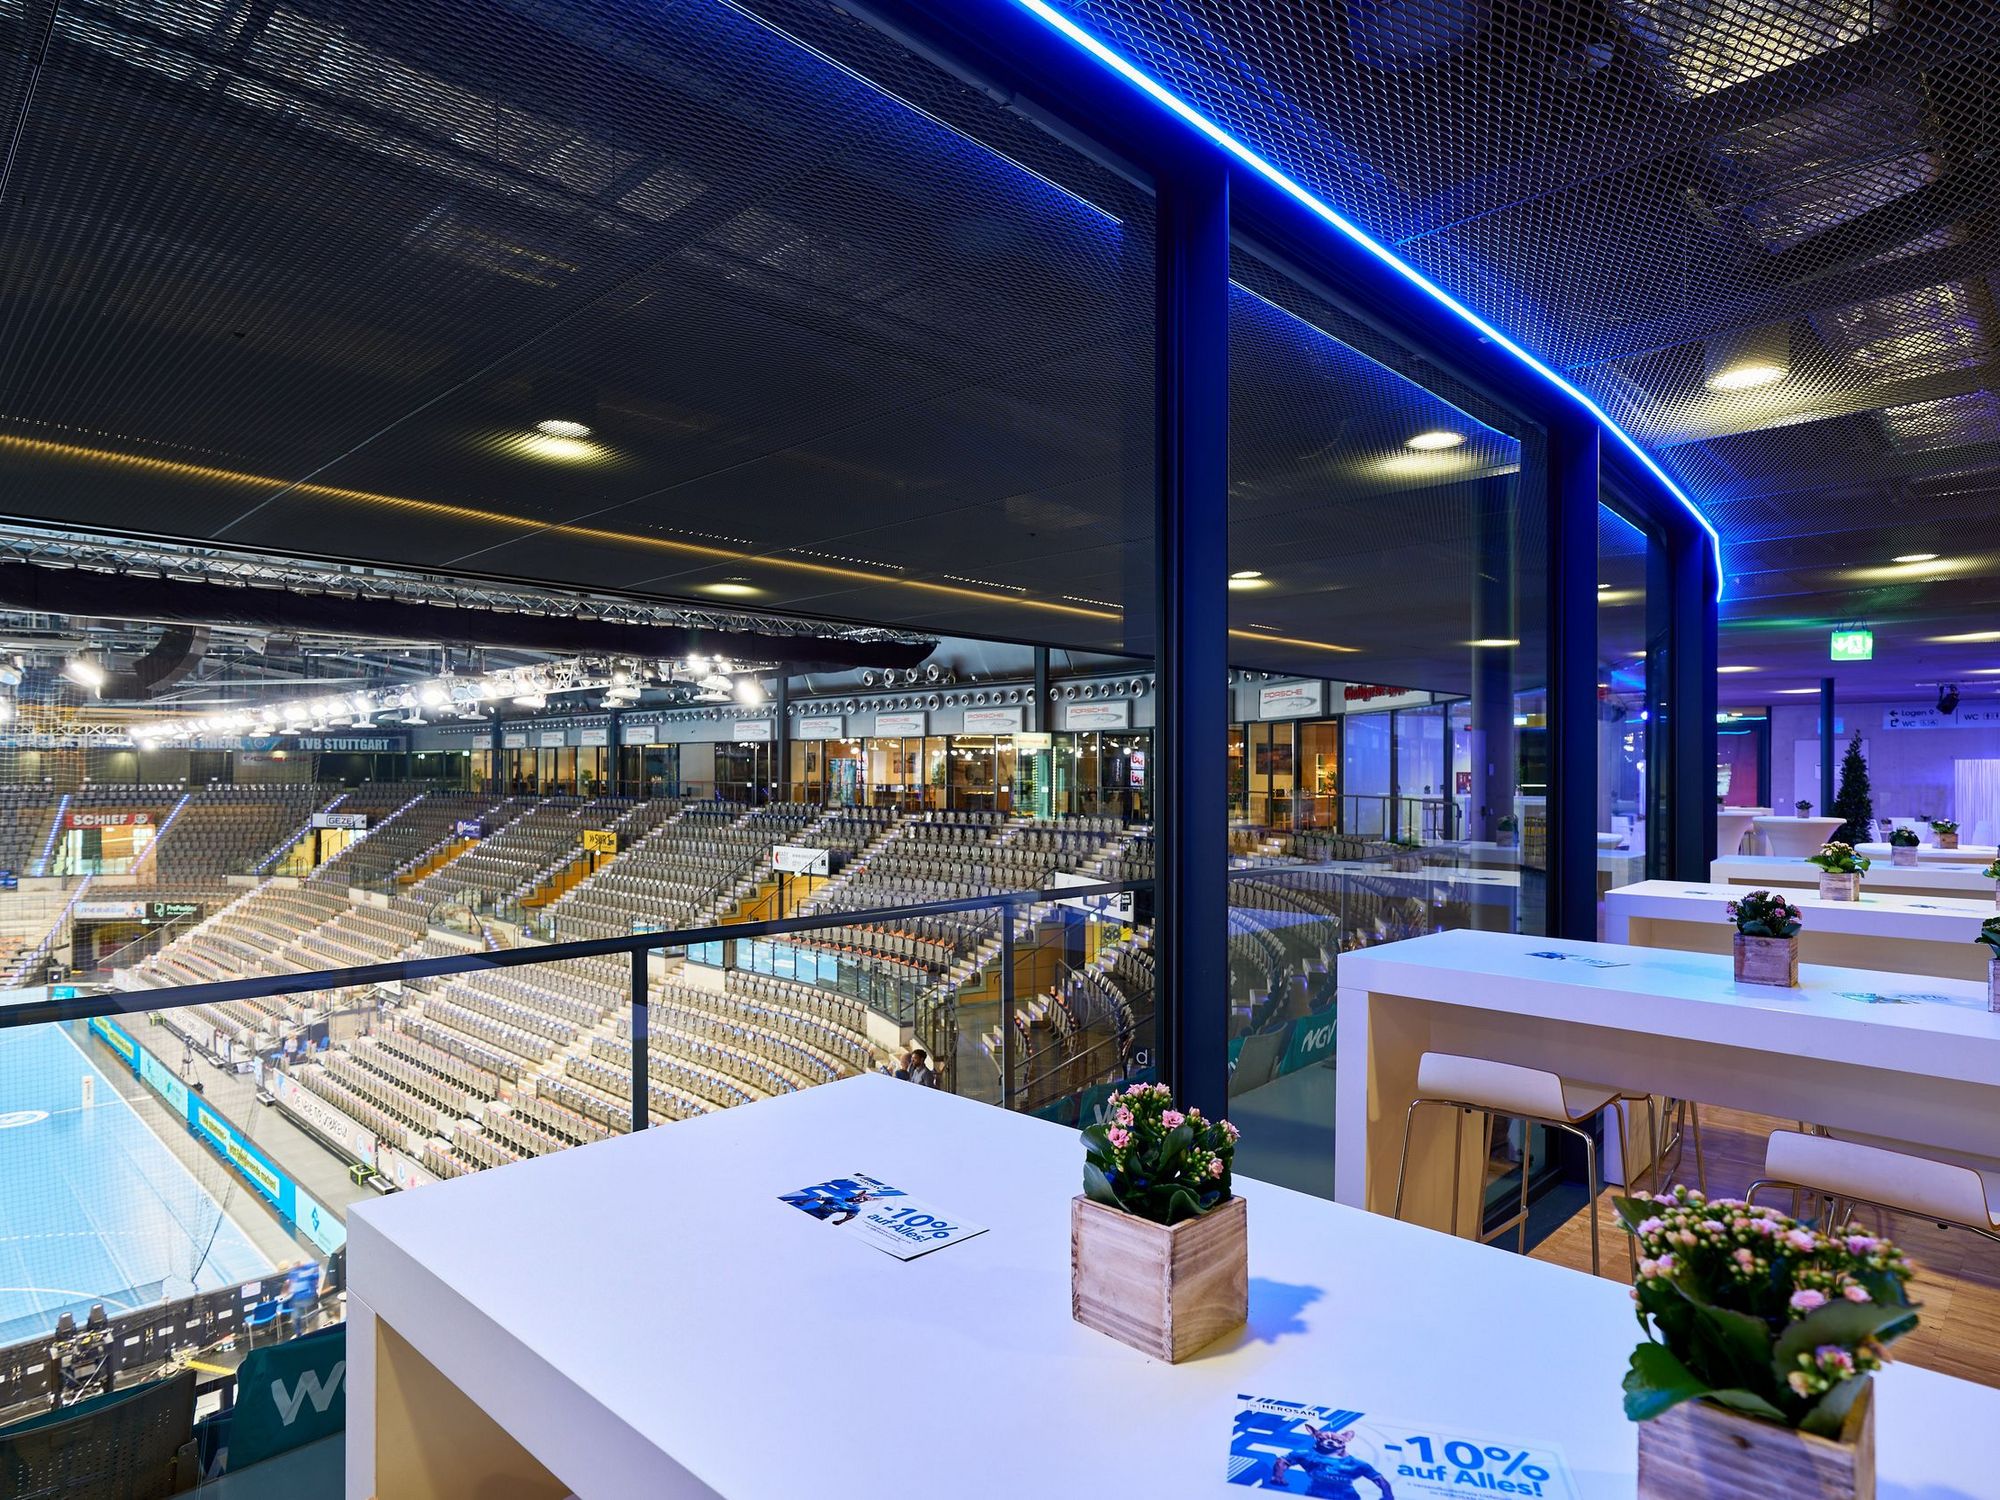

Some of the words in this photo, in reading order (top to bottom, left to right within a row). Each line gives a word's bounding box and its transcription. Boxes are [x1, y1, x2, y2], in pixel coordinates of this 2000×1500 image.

[1264, 688, 1303, 699] PORSCHE
[1070, 704, 1109, 713] PORSCHE
[1901, 709, 1927, 717] Logen
[298, 738, 321, 750] TVB
[324, 738, 389, 751] STUTTGART
[72, 814, 129, 826] SCHIEF
[328, 817, 353, 825] GEZE
[867, 1213, 898, 1226] auf
[887, 1224, 932, 1243] Alles!
[883, 1206, 959, 1239] -10%
[271, 1360, 346, 1427] W
[1262, 1404, 1316, 1417] HEROSAN
[1384, 1436, 1550, 1481] -10%
[1397, 1464, 1447, 1482] auf
[1453, 1469, 1543, 1497] Alles!
